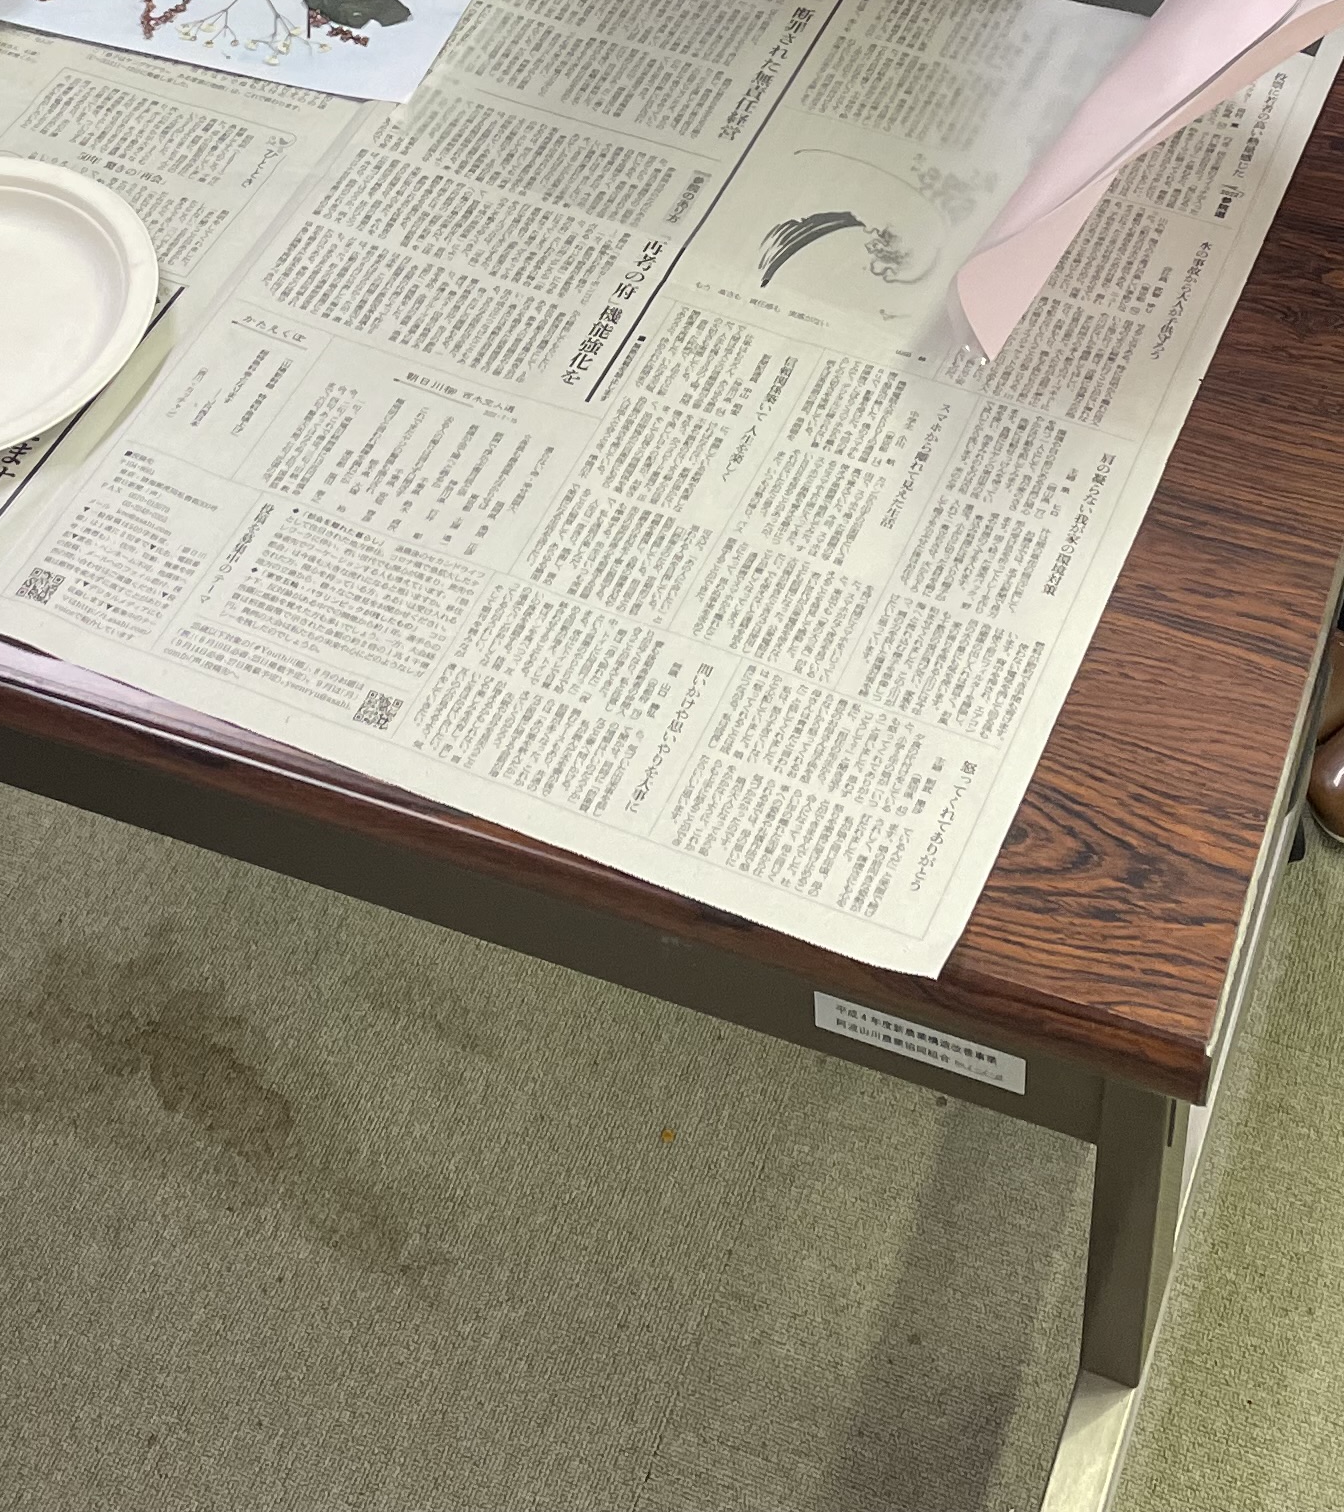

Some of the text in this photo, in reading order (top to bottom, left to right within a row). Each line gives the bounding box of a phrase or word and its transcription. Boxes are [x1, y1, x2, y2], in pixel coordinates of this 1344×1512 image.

[711, 5, 820, 142] 断罪された無責任経営
[237, 313, 310, 344] かたえくぼ
[553, 230, 676, 388] 「再考の府」機能強化を
[402, 370, 462, 397] 朝日川柳
[715, 422, 763, 484] 人生を楽しく
[877, 402, 957, 530] スマホから離れて見えた生活
[1038, 451, 1119, 597] 肩の凝らない我が家の環境対策
[618, 661, 718, 815] 問いかけや思いやりを大事に
[904, 758, 980, 895] 怒ってくれてありがとう
